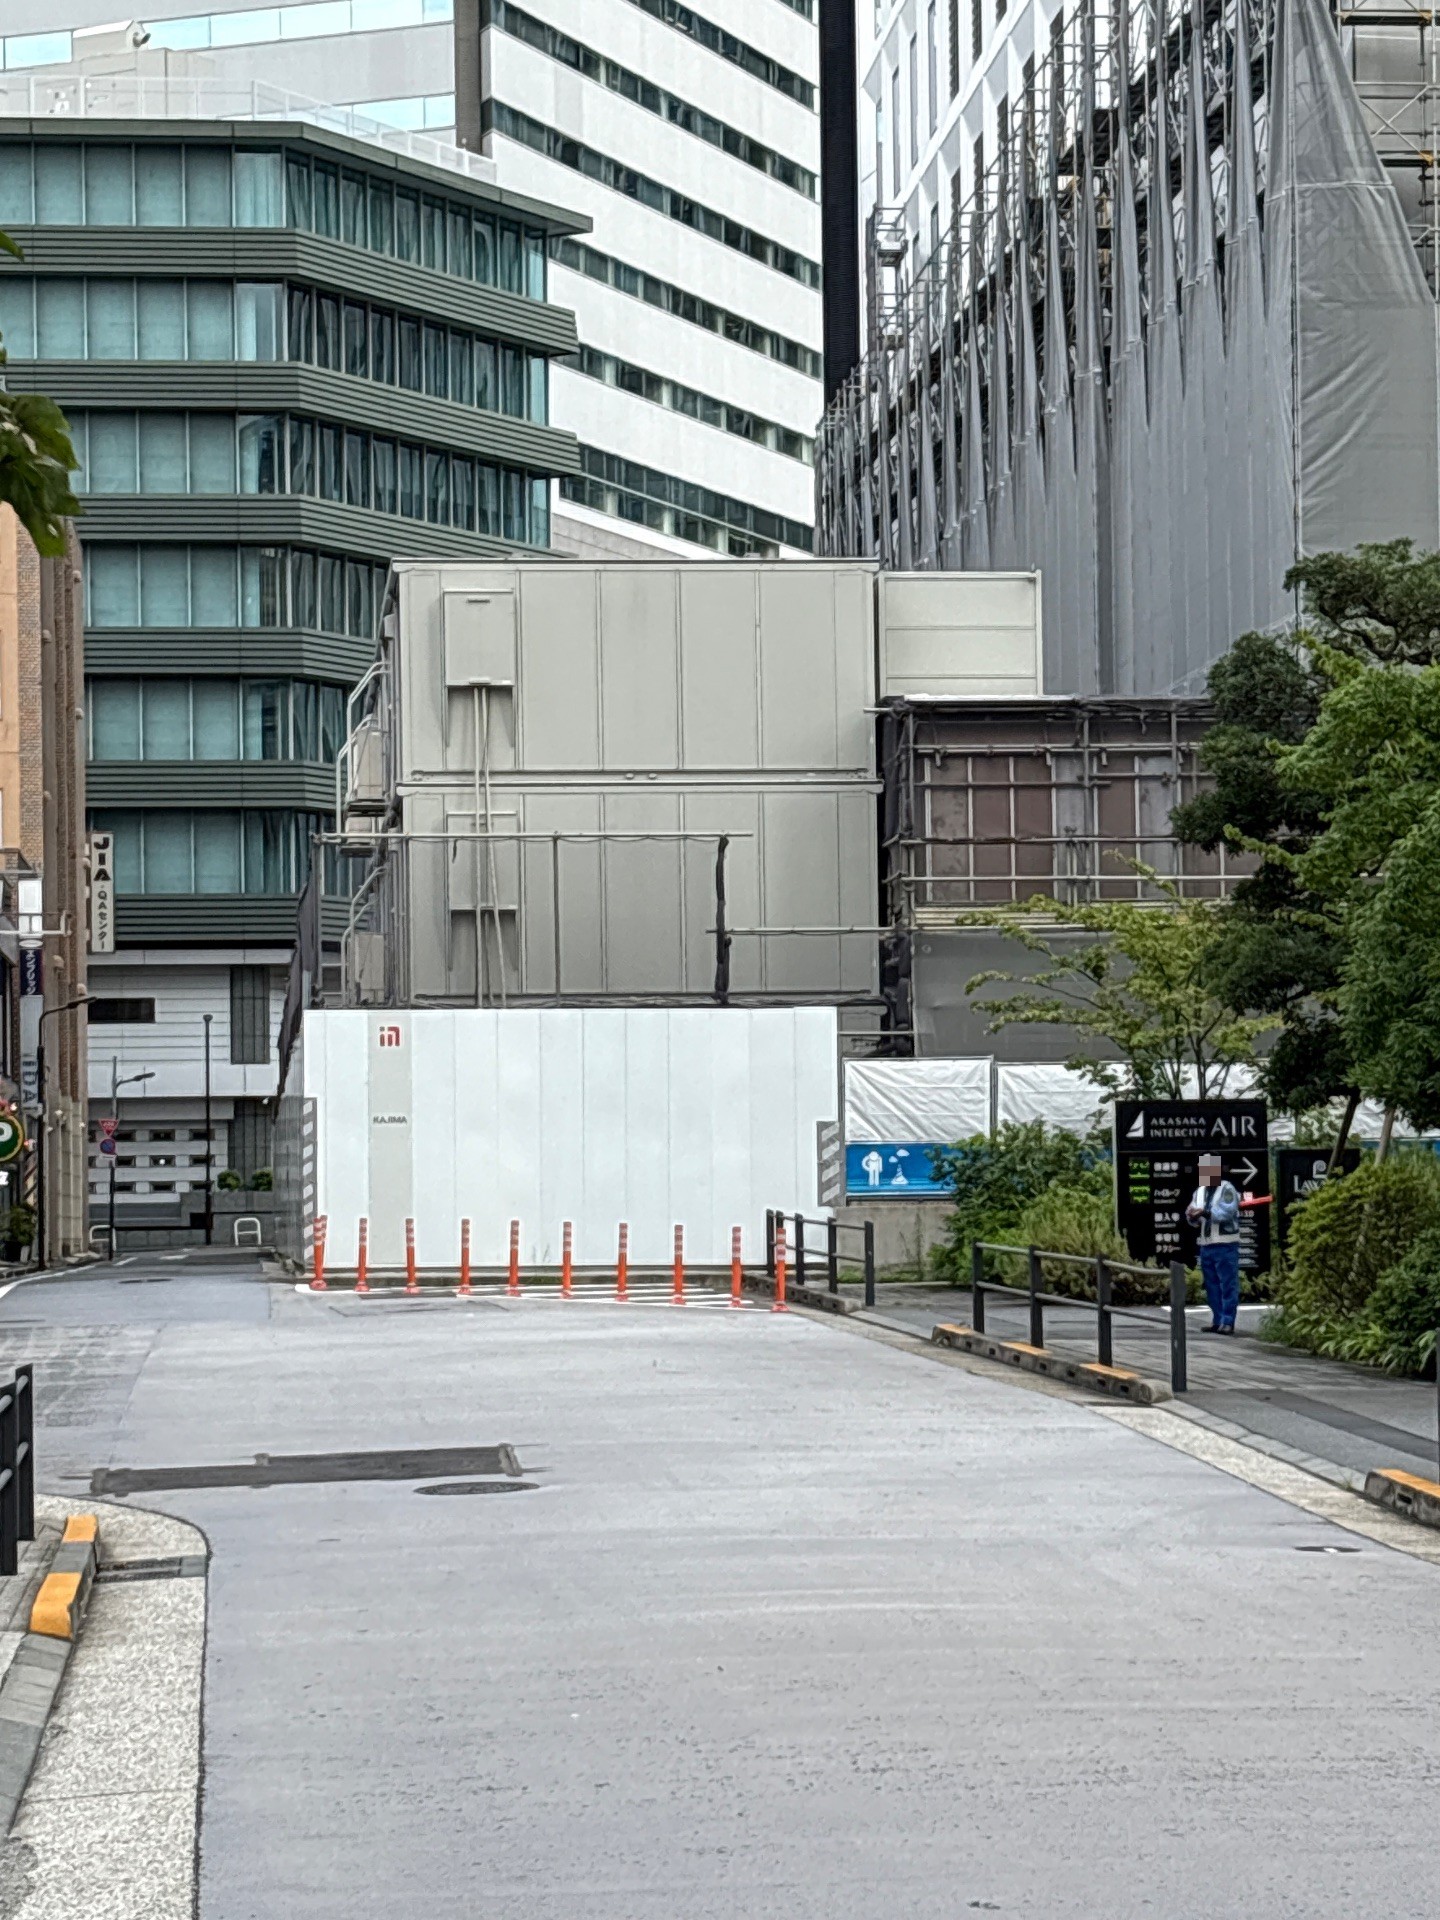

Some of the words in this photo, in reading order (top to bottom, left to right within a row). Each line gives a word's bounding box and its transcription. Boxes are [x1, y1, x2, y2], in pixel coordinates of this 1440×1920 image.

[373, 1116, 407, 1124] KAJIMA
[1149, 1117, 1206, 1126] AKASAKA
[1210, 1116, 1257, 1137] AIR
[1149, 1128, 1206, 1138] INTERCITY
